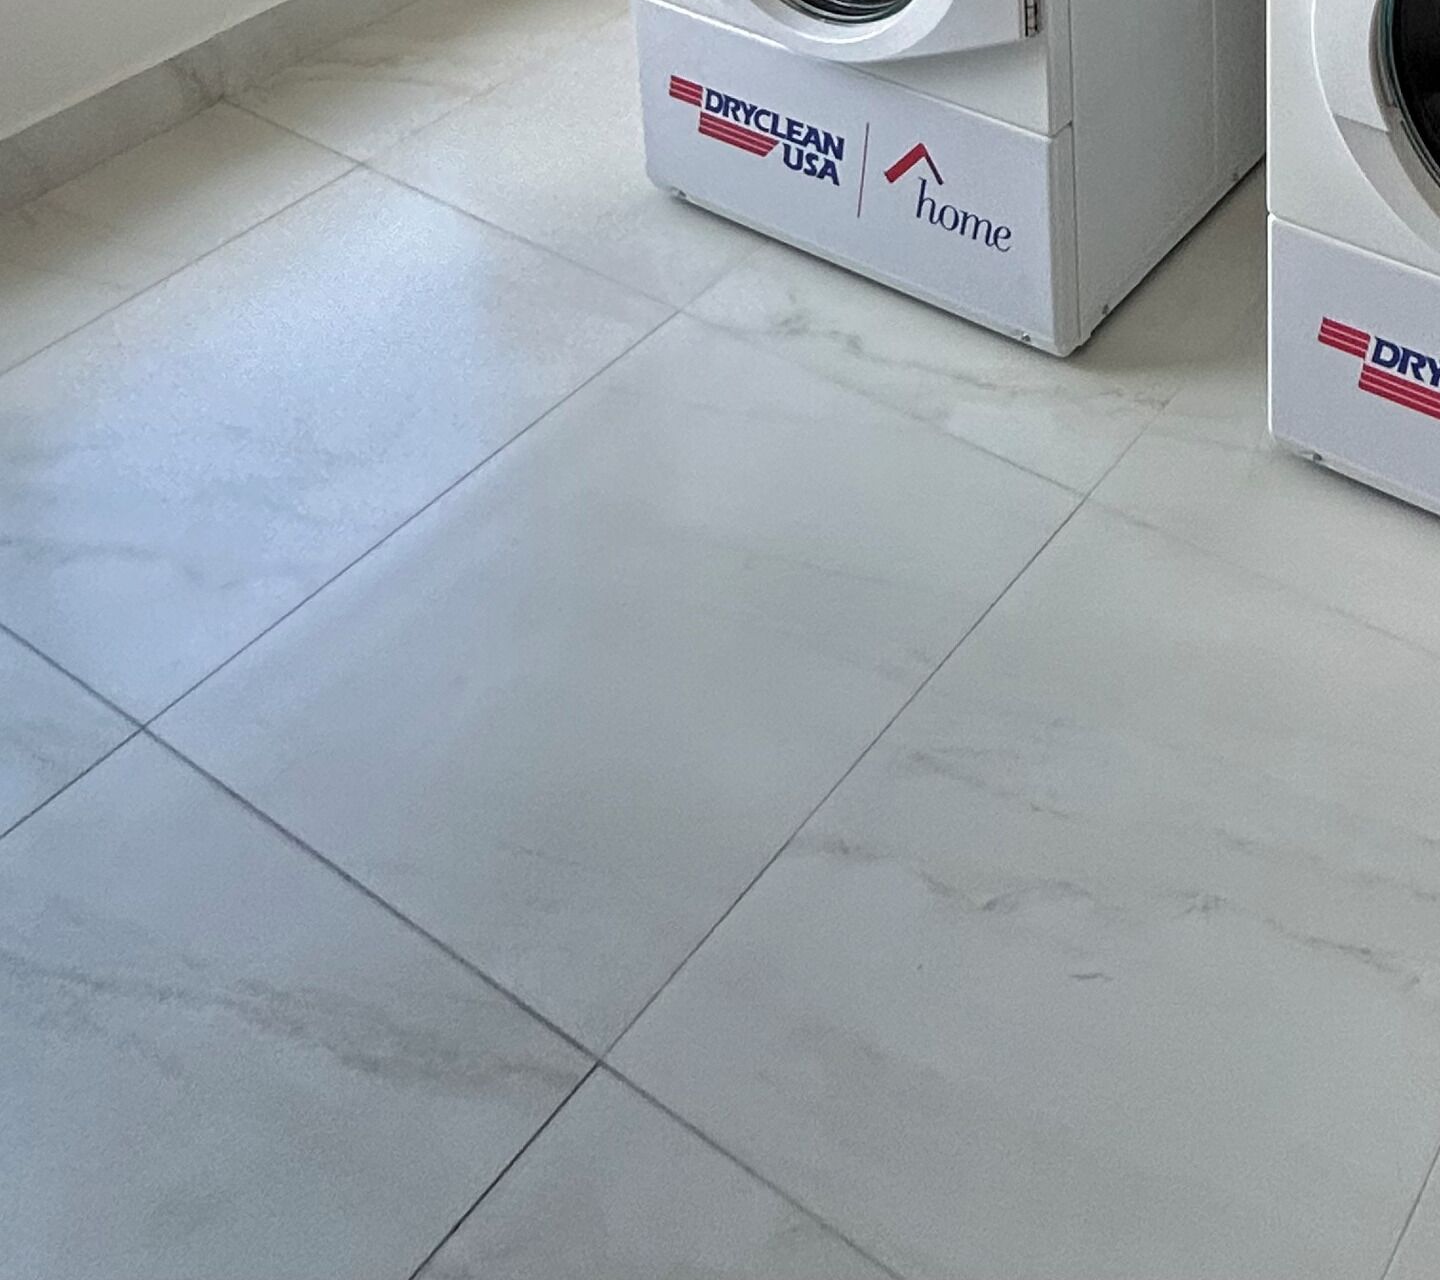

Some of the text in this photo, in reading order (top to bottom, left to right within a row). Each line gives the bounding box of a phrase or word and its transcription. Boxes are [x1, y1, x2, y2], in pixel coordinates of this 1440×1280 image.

[705, 87, 845, 162] DRYCLEAN
[782, 142, 841, 187] USA
[916, 176, 1012, 253] home
